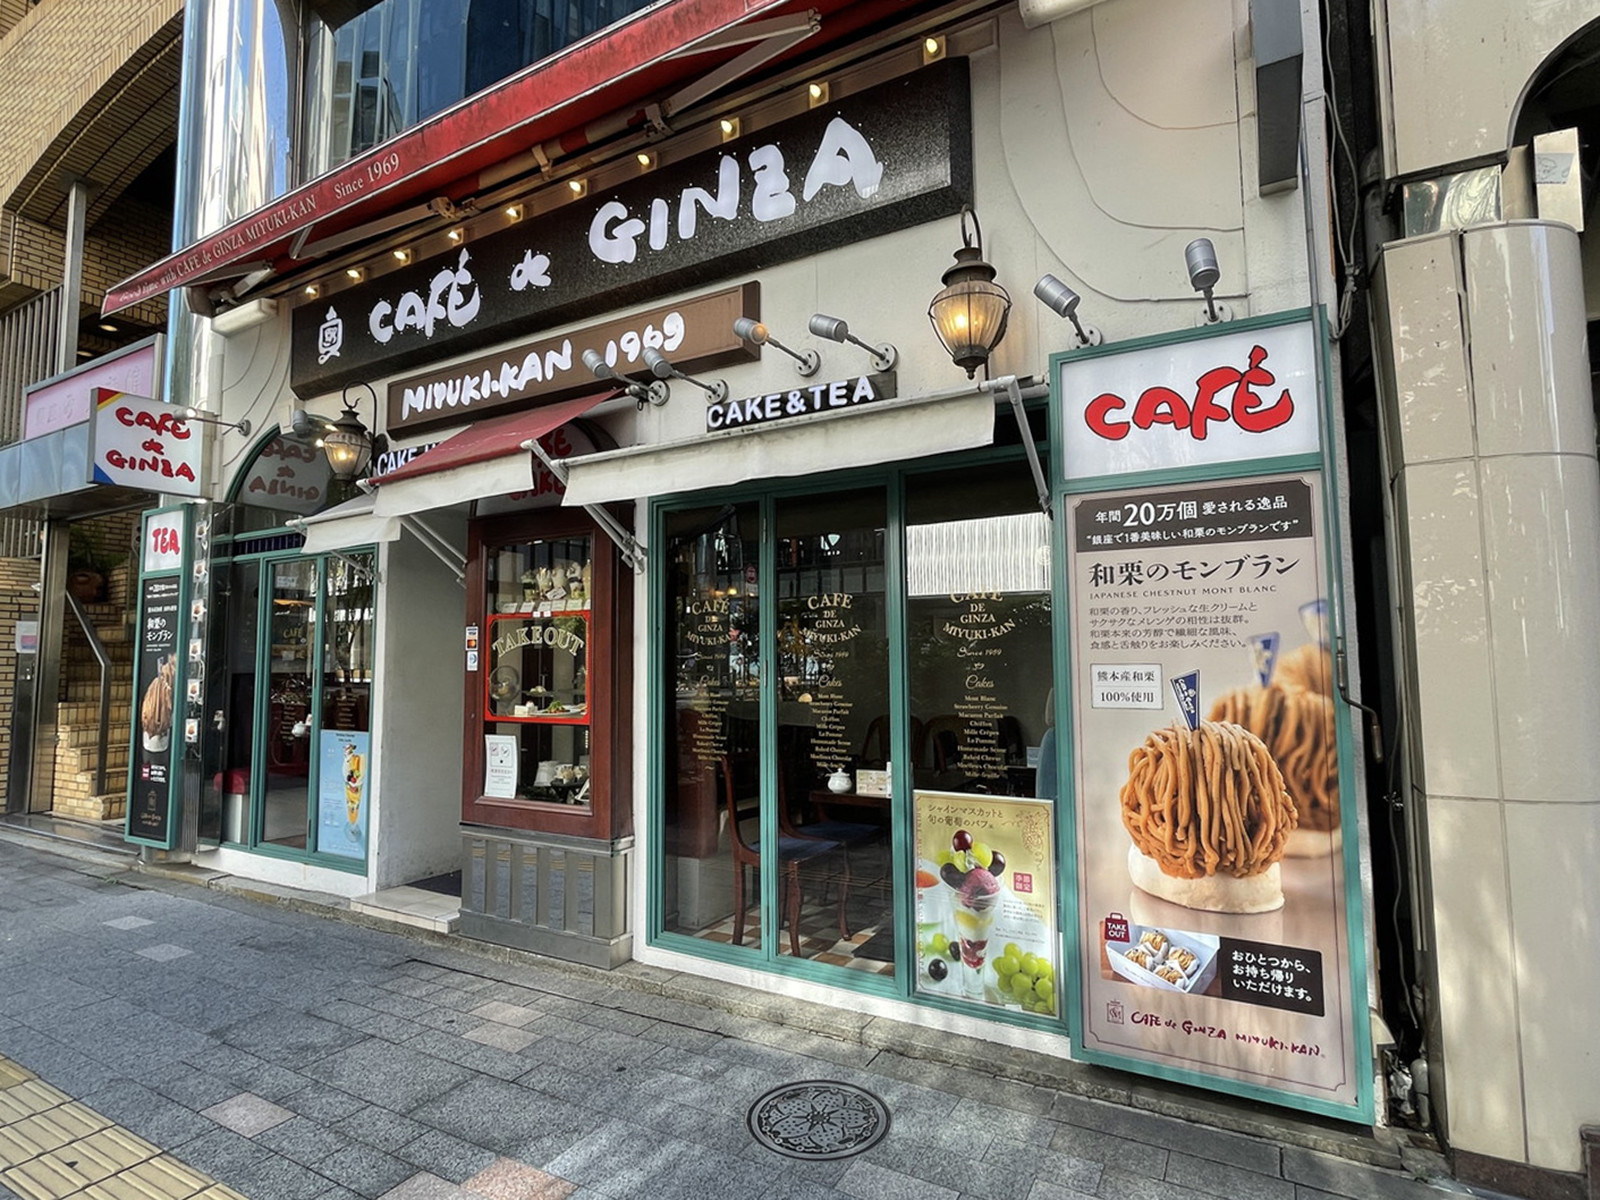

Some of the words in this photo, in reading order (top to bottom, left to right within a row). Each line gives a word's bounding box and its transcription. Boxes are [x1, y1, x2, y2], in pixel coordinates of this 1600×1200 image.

[511, 249, 552, 291] de
[587, 116, 884, 264] GINZA
[160, 267, 177, 285] with
[202, 249, 212, 265] de
[212, 232, 245, 262] GINZA
[245, 194, 317, 242] MIYUKI-KAN
[333, 182, 364, 200] Since
[367, 152, 400, 183] 1969
[604, 311, 685, 368] 1969
[141, 438, 165, 455] de
[105, 449, 196, 482] GINZA
[1202, 495, 1289, 516] 愛される逸品
[152, 527, 181, 555] TEA
[1088, 554, 1301, 588] 和栗のモンブラン
[1089, 590, 1138, 600] JAPANESE
[1142, 588, 1197, 598] CHESTNUT
[1202, 586, 1233, 595] MONT
[1239, 584, 1277, 594] BLANC
[822, 610, 837, 619] DE
[970, 603, 986, 613] DE
[815, 619, 845, 629] GINZA
[960, 613, 996, 624] GINZA
[146, 629, 174, 642] モンブラン
[943, 618, 1016, 641] MIYUKI-KAN
[964, 673, 995, 690] Cakes
[1097, 670, 1156, 683] 熊本産和栗
[1100, 690, 1154, 703] 100%使用
[927, 804, 1004, 819] シャインマスカットと
[1107, 922, 1127, 931] TAKE
[1108, 930, 1125, 938] OUT
[1231, 950, 1311, 974] おひとつから、
[1232, 964, 1294, 984] お持ち帰り
[1232, 978, 1312, 1002] いただけます。
[1131, 1011, 1162, 1028] CAFE
[1164, 1019, 1177, 1029] de
[1182, 1019, 1227, 1039] GINZA
